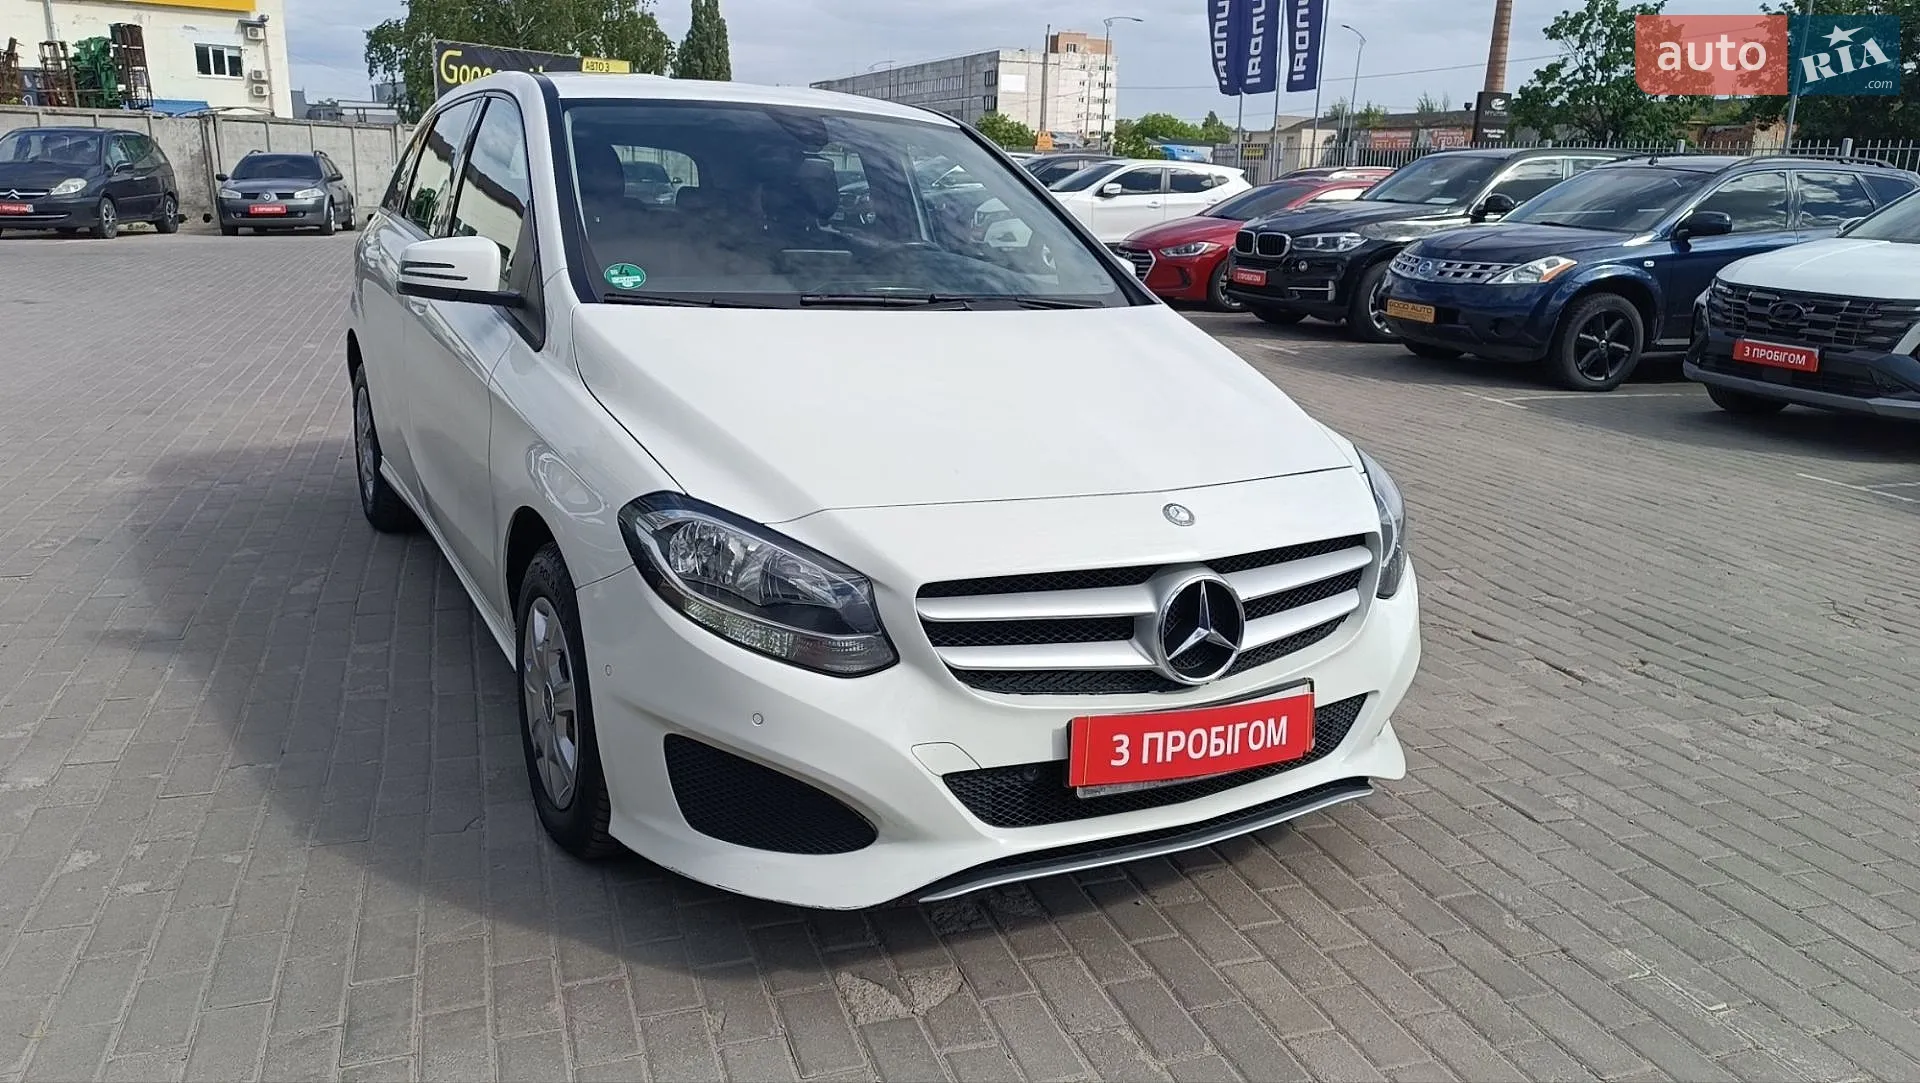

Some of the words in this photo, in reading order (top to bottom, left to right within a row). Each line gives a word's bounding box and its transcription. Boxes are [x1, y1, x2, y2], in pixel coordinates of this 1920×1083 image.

[585, 61, 604, 72] АВТО
[1752, 348, 1806, 366] ПРОБІГОМ
[1110, 733, 1131, 767] З
[1141, 715, 1288, 764] ПРОБІГОМ
